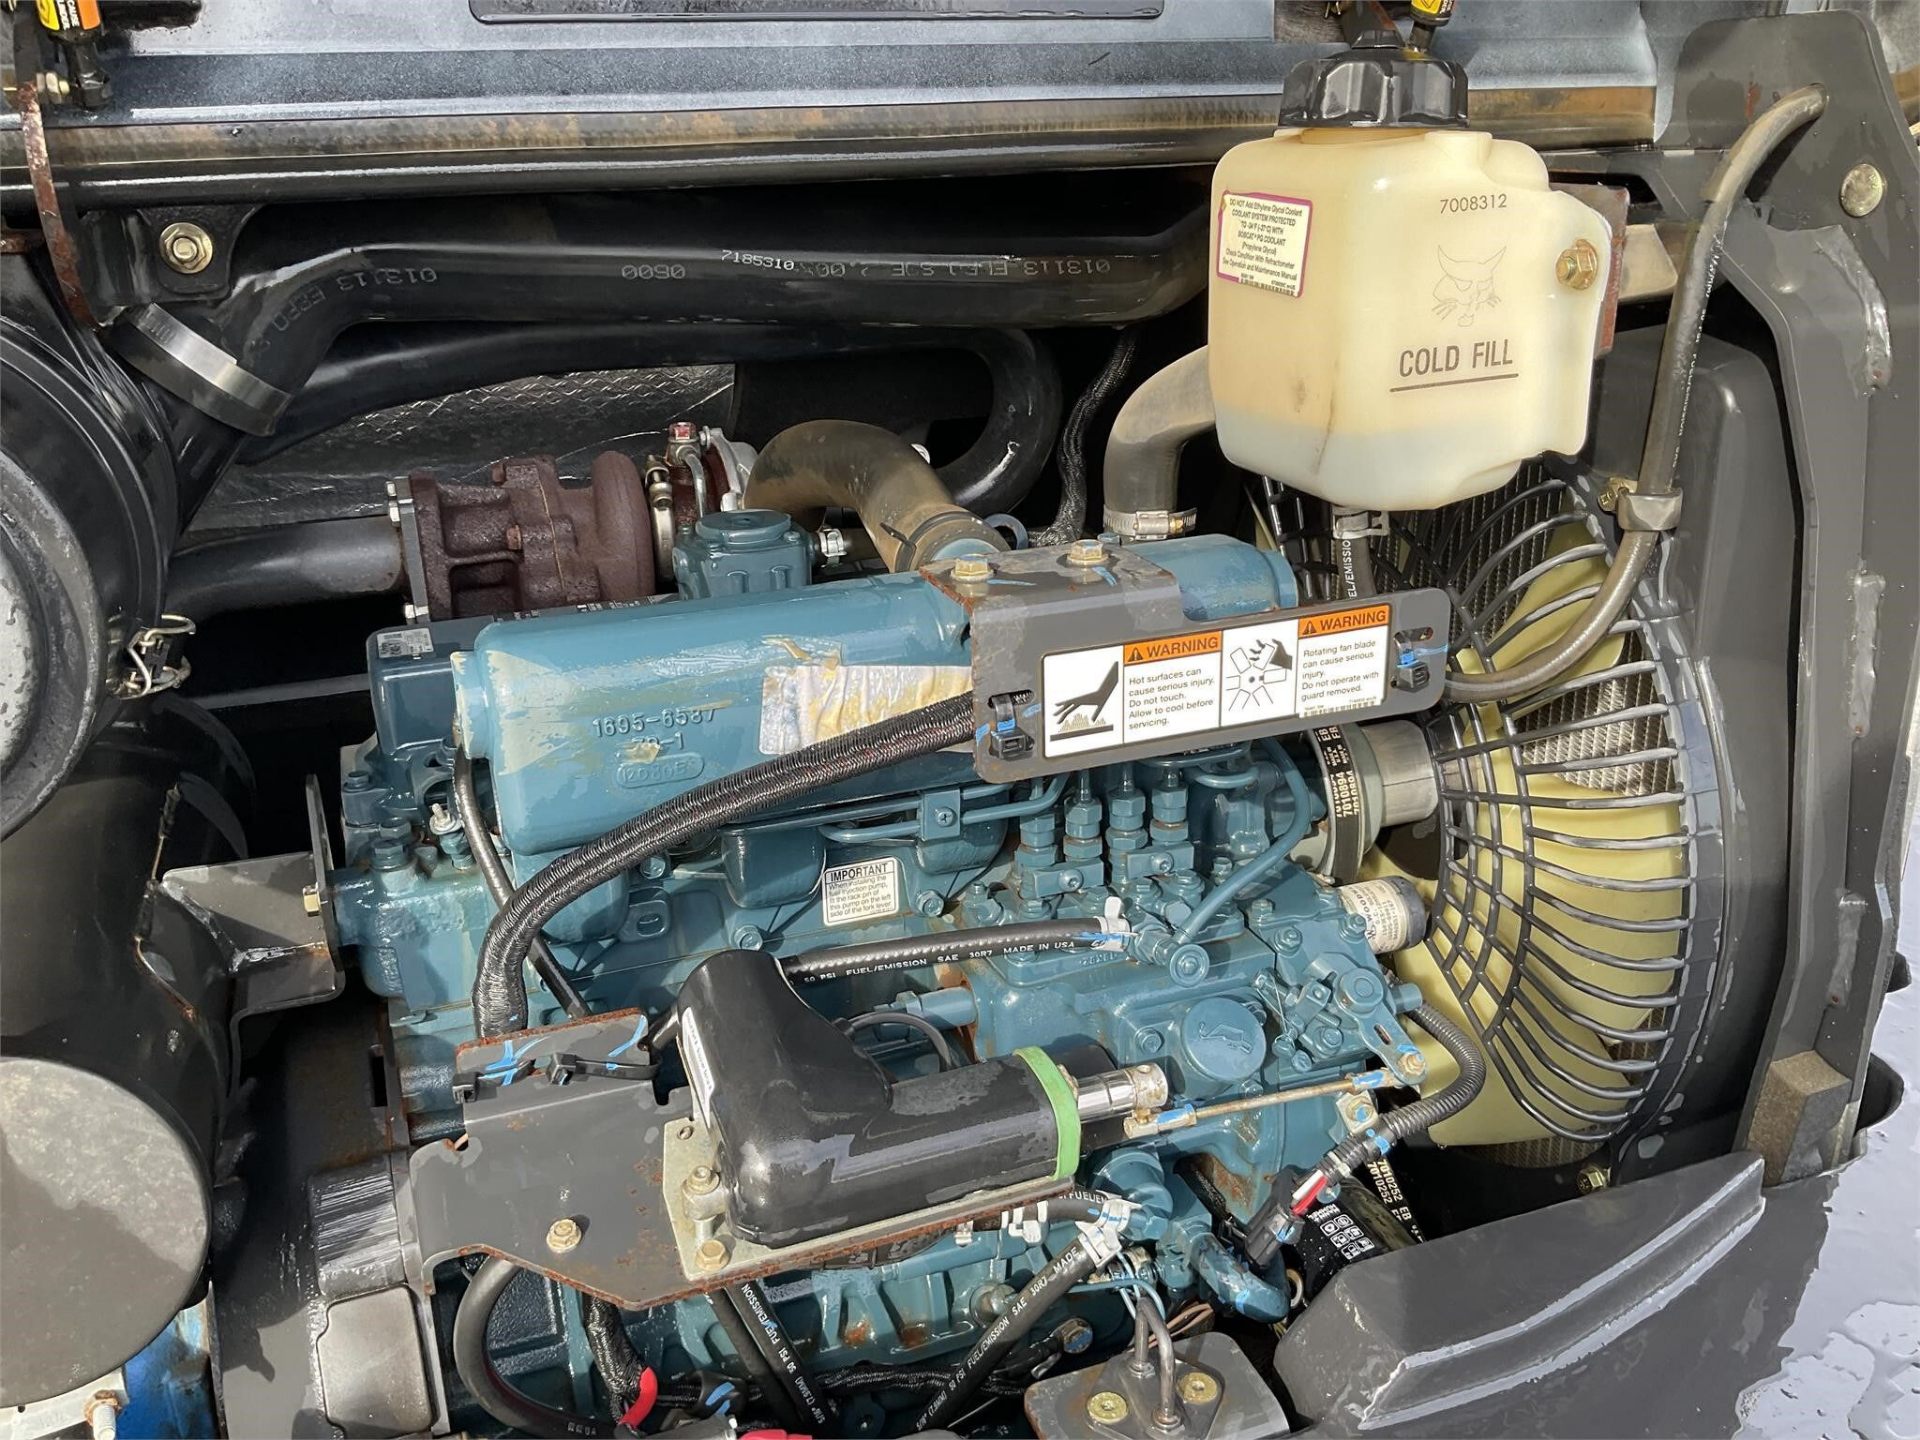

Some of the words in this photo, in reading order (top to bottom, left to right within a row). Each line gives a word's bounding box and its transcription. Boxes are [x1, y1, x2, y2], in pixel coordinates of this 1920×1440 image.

[1254, 202, 1271, 212] Ethylene
[1285, 206, 1302, 216] Coolant
[1440, 194, 1506, 214] 7008312
[1232, 209, 1251, 219] COOLANT
[1252, 212, 1268, 222] SYSTEM
[1269, 215, 1296, 227] PROTECTED
[1264, 235, 1286, 246] COOLANT
[721, 250, 795, 270] 7185310
[1400, 346, 1459, 377] COLD
[1473, 339, 1513, 368] FILL
[1320, 611, 1386, 630] WARNING
[1146, 636, 1218, 657] WARNING
[1303, 646, 1337, 658] Rotating
[1340, 644, 1352, 652] fan
[1354, 640, 1376, 650] blade
[1320, 657, 1343, 666] cause
[1346, 651, 1374, 662] serious
[1130, 676, 1144, 685] Hot
[1147, 671, 1183, 682] surfaces
[1302, 670, 1324, 680] injury.
[1302, 682, 1313, 690] Do
[1315, 680, 1328, 688] not
[1331, 675, 1361, 688] operate
[1362, 671, 1379, 679] with
[1129, 687, 1155, 696] cause
[1158, 681, 1188, 692] serious
[1190, 677, 1214, 688] injury.
[1301, 691, 1324, 702] guard
[1327, 685, 1362, 696] removed.
[1129, 698, 1141, 707] Do
[1144, 696, 1157, 704] not
[1160, 692, 1186, 702] touch.
[1129, 709, 1152, 718] Allow
[1166, 703, 1184, 712] cool
[1186, 698, 1213, 709] before
[1129, 717, 1169, 730] servicing.
[1336, 771, 1353, 817] 7010894
[830, 863, 888, 882] IMPORTANT
[820, 972, 837, 981] PSI
[846, 958, 927, 976] FUEL/EMISSION
[937, 954, 959, 963] SAE
[969, 951, 993, 960] 30R7
[1003, 945, 1033, 955] MADE
[1038, 944, 1050, 952] IN
[1054, 941, 1074, 950] USA
[1367, 1162, 1393, 1204] 7010252
[1378, 1159, 1403, 1202] 7010252
[1400, 1206, 1412, 1220] EB
[741, 1284, 780, 1344] FUEL/EMISSION
[956, 1369, 966, 1382] PSI
[967, 1318, 1010, 1370] FUEL/EMISSION
[1012, 1298, 1028, 1316] SAE
[1030, 1276, 1048, 1296] 30R7
[1053, 1246, 1080, 1275] MADE
[778, 1348, 790, 1362] PSI
